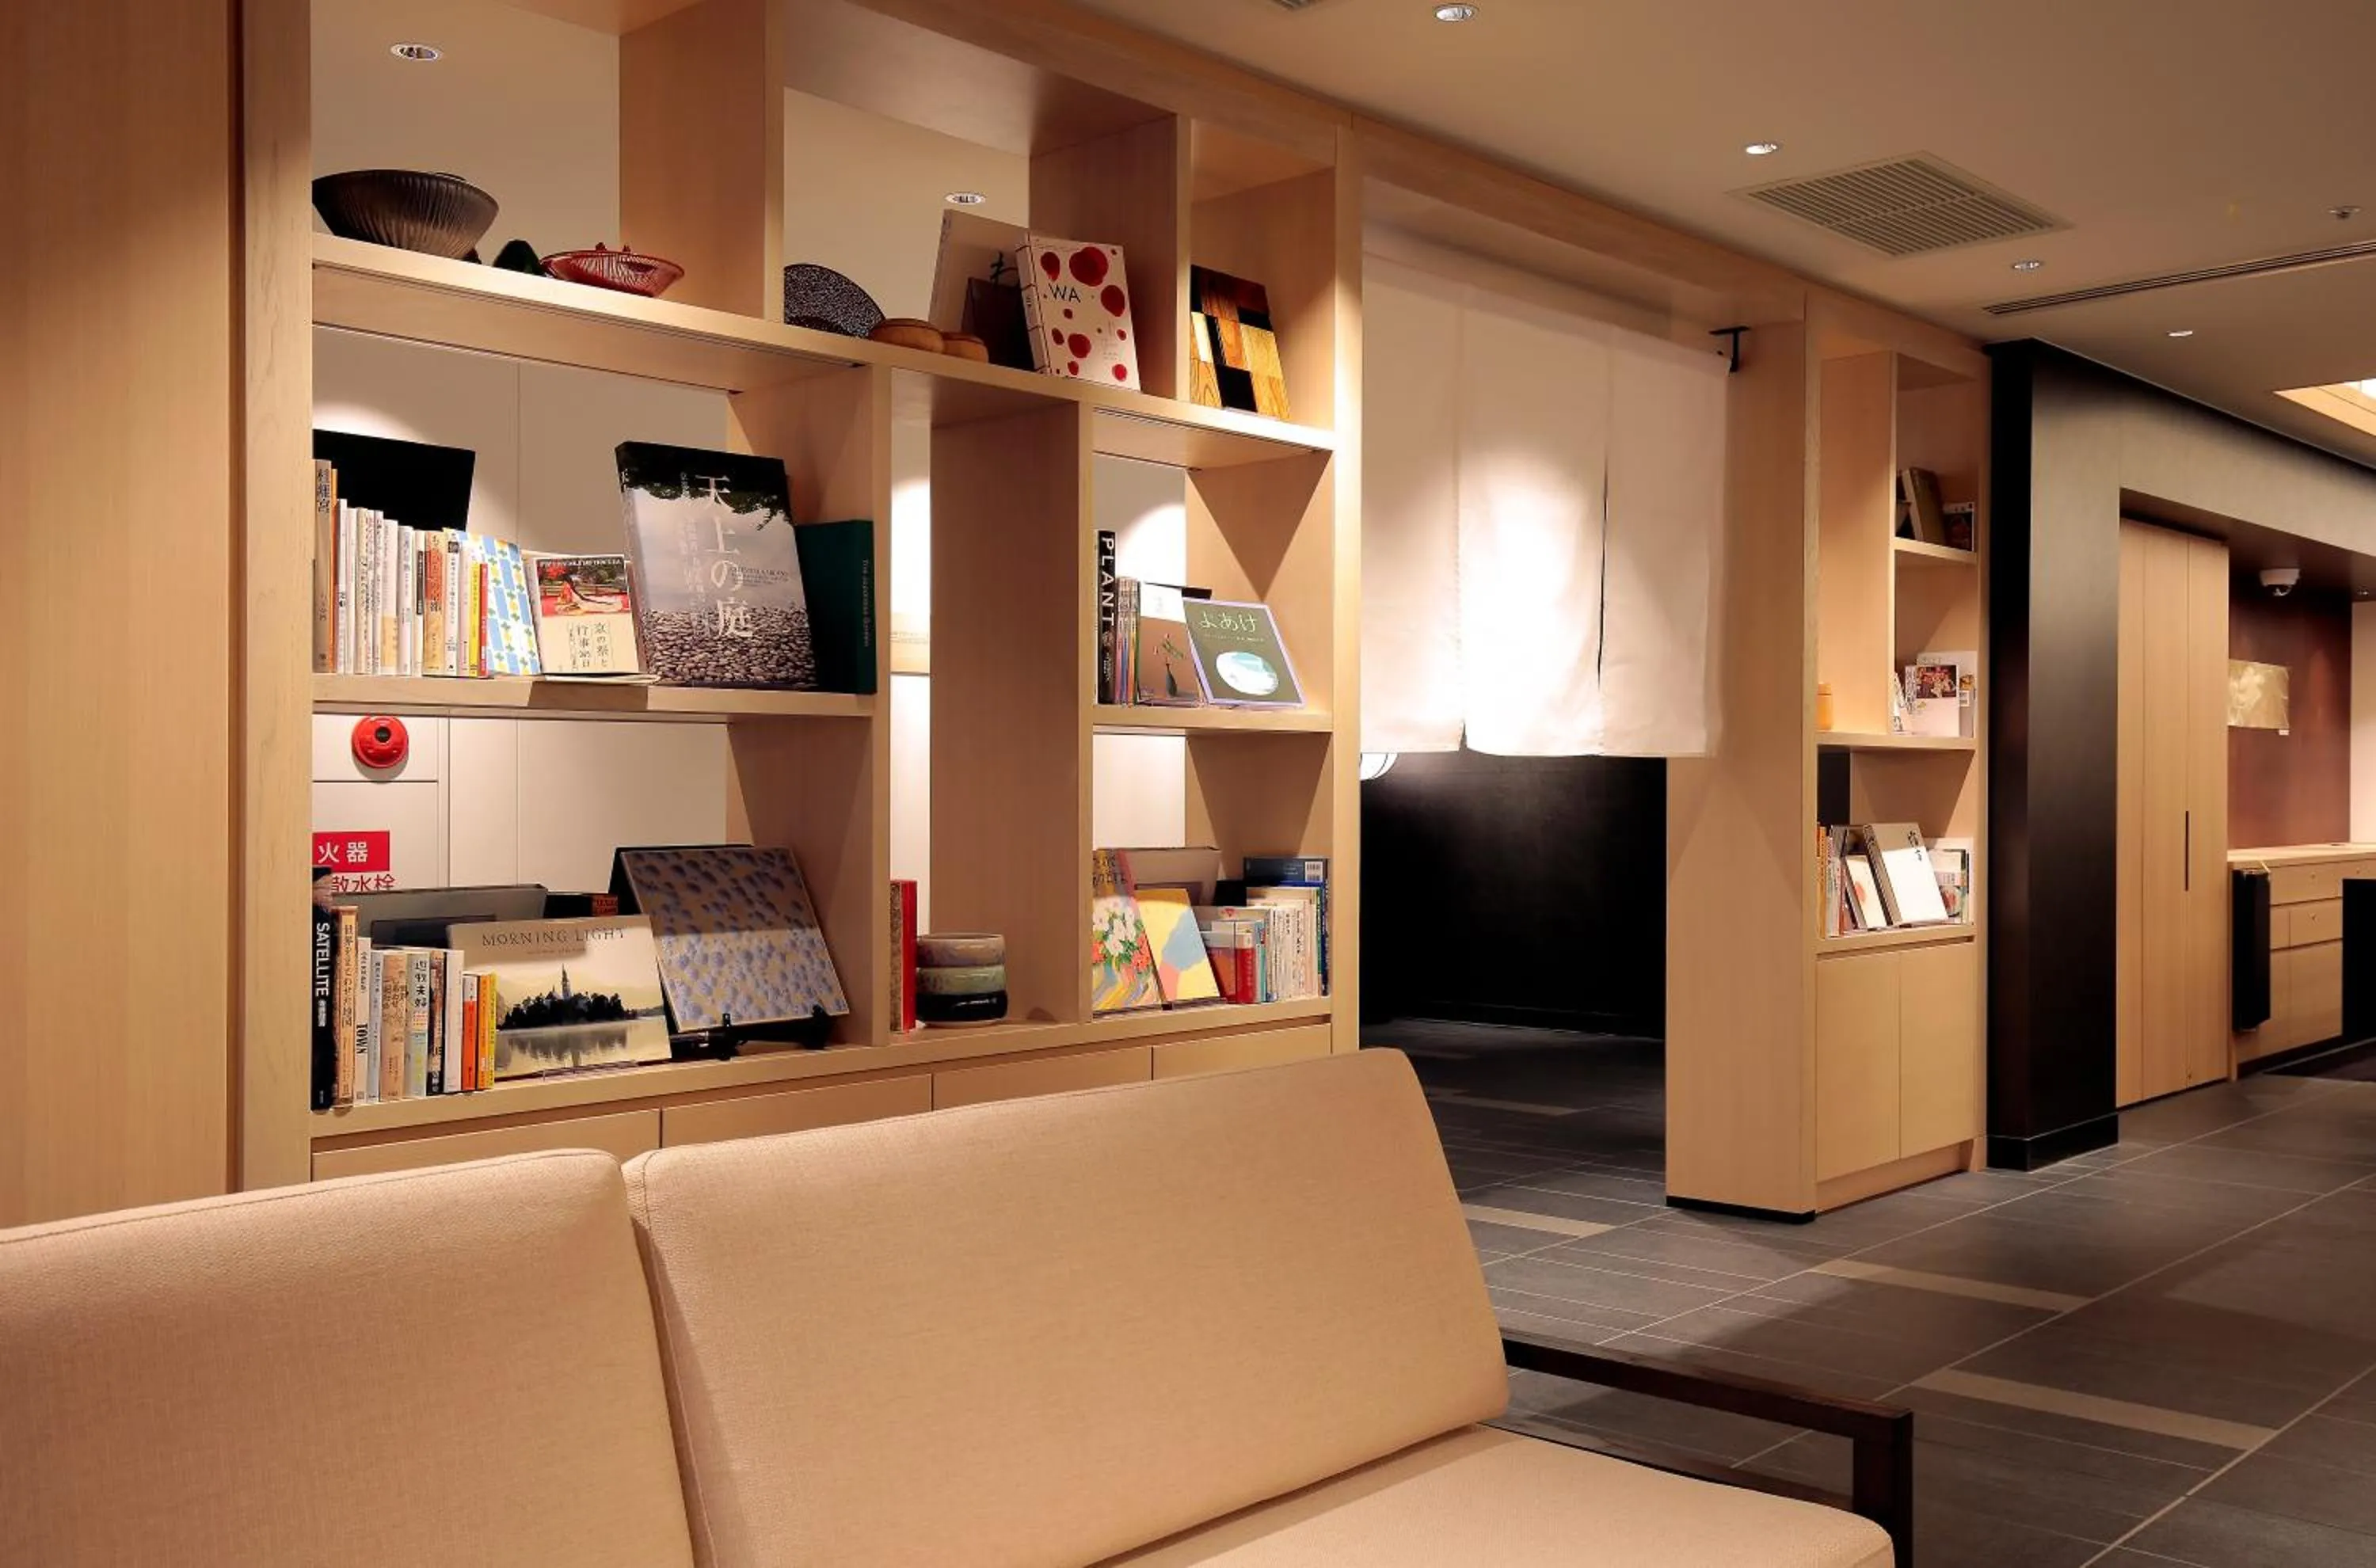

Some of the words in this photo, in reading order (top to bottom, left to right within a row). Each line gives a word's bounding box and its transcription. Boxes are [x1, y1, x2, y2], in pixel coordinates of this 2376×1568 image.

[1048, 282, 1082, 304] WA
[695, 474, 753, 636] 天上の庭
[1101, 536, 1115, 626] PLANT
[1200, 611, 1258, 633] よあけ
[318, 842, 368, 863] 火器
[482, 930, 568, 947] MORNING
[575, 927, 625, 942] LIGHT
[315, 922, 330, 996] SATELLITE
